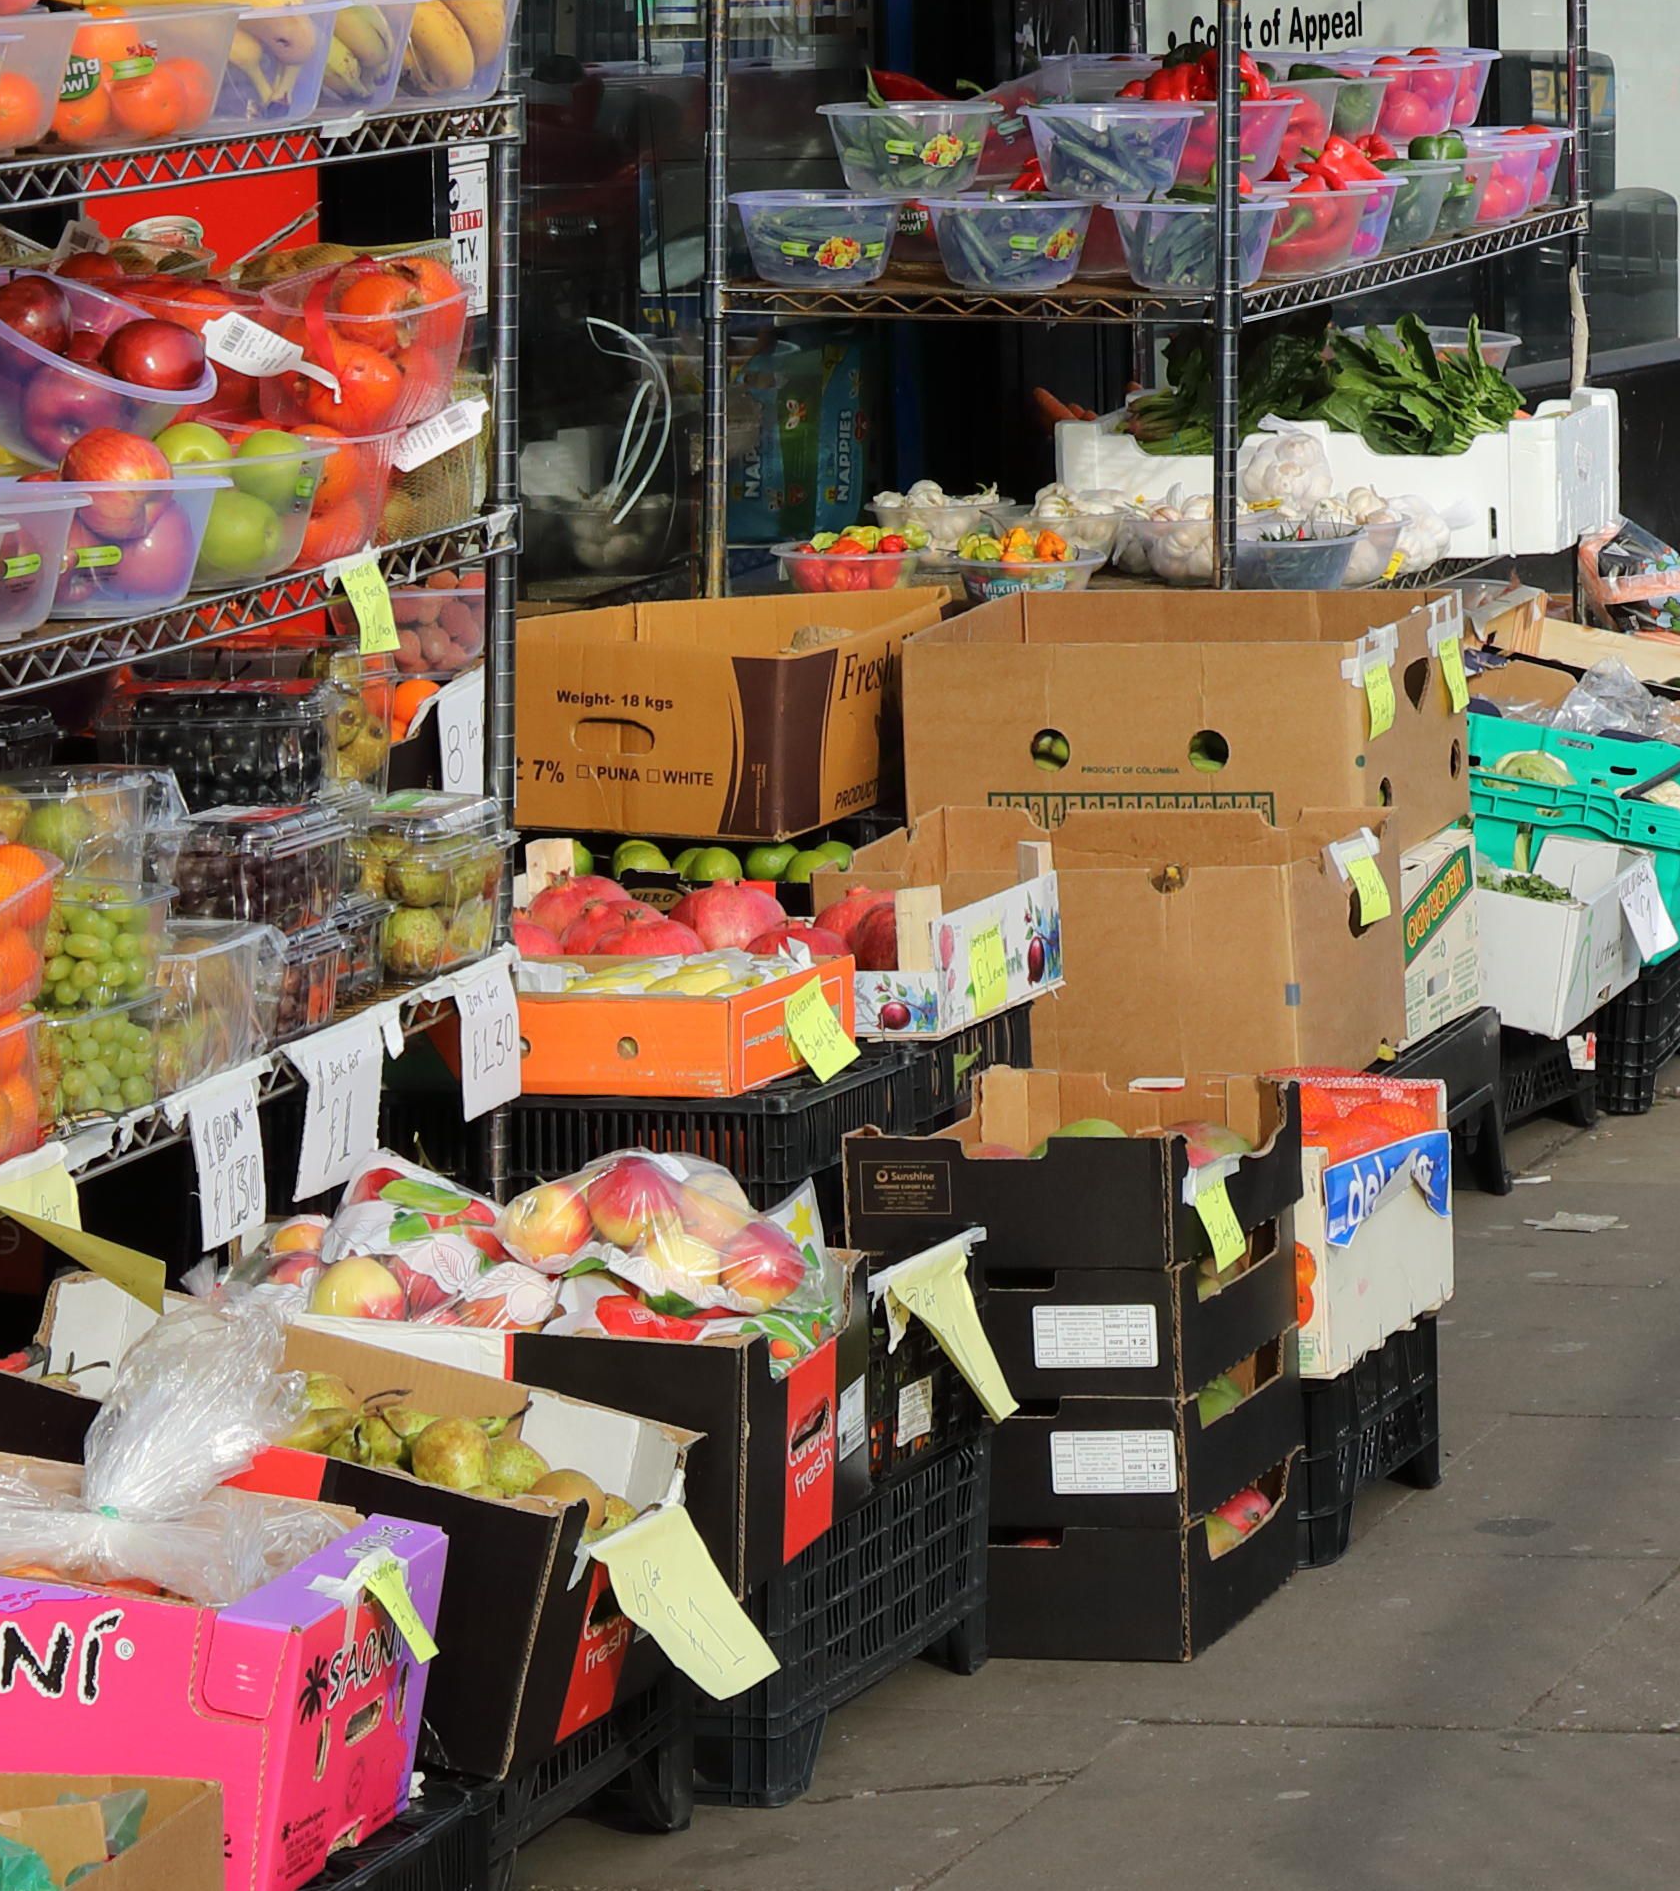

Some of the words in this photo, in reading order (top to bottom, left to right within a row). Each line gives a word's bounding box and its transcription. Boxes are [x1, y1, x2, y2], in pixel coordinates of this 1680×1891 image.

[1260, 9, 1283, 44] of
[1289, 0, 1364, 50] Appeal
[839, 641, 895, 701] Fresh
[556, 689, 615, 708] Weight-
[622, 693, 640, 708] 18
[644, 694, 673, 711] kgs
[532, 759, 565, 785] 7%
[598, 765, 640, 782] PUNA
[663, 770, 714, 786] WHITE
[1081, 766, 1120, 774] PRODUCT
[1135, 767, 1180, 775] COLOMBIA
[835, 778, 879, 811] PRODUCT
[1408, 857, 1466, 948] MEJORADO
[891, 1171, 935, 1182] Sunshine
[1131, 1337, 1146, 1346] 12
[793, 1445, 834, 1499] fresh
[1151, 1462, 1167, 1471] 12
